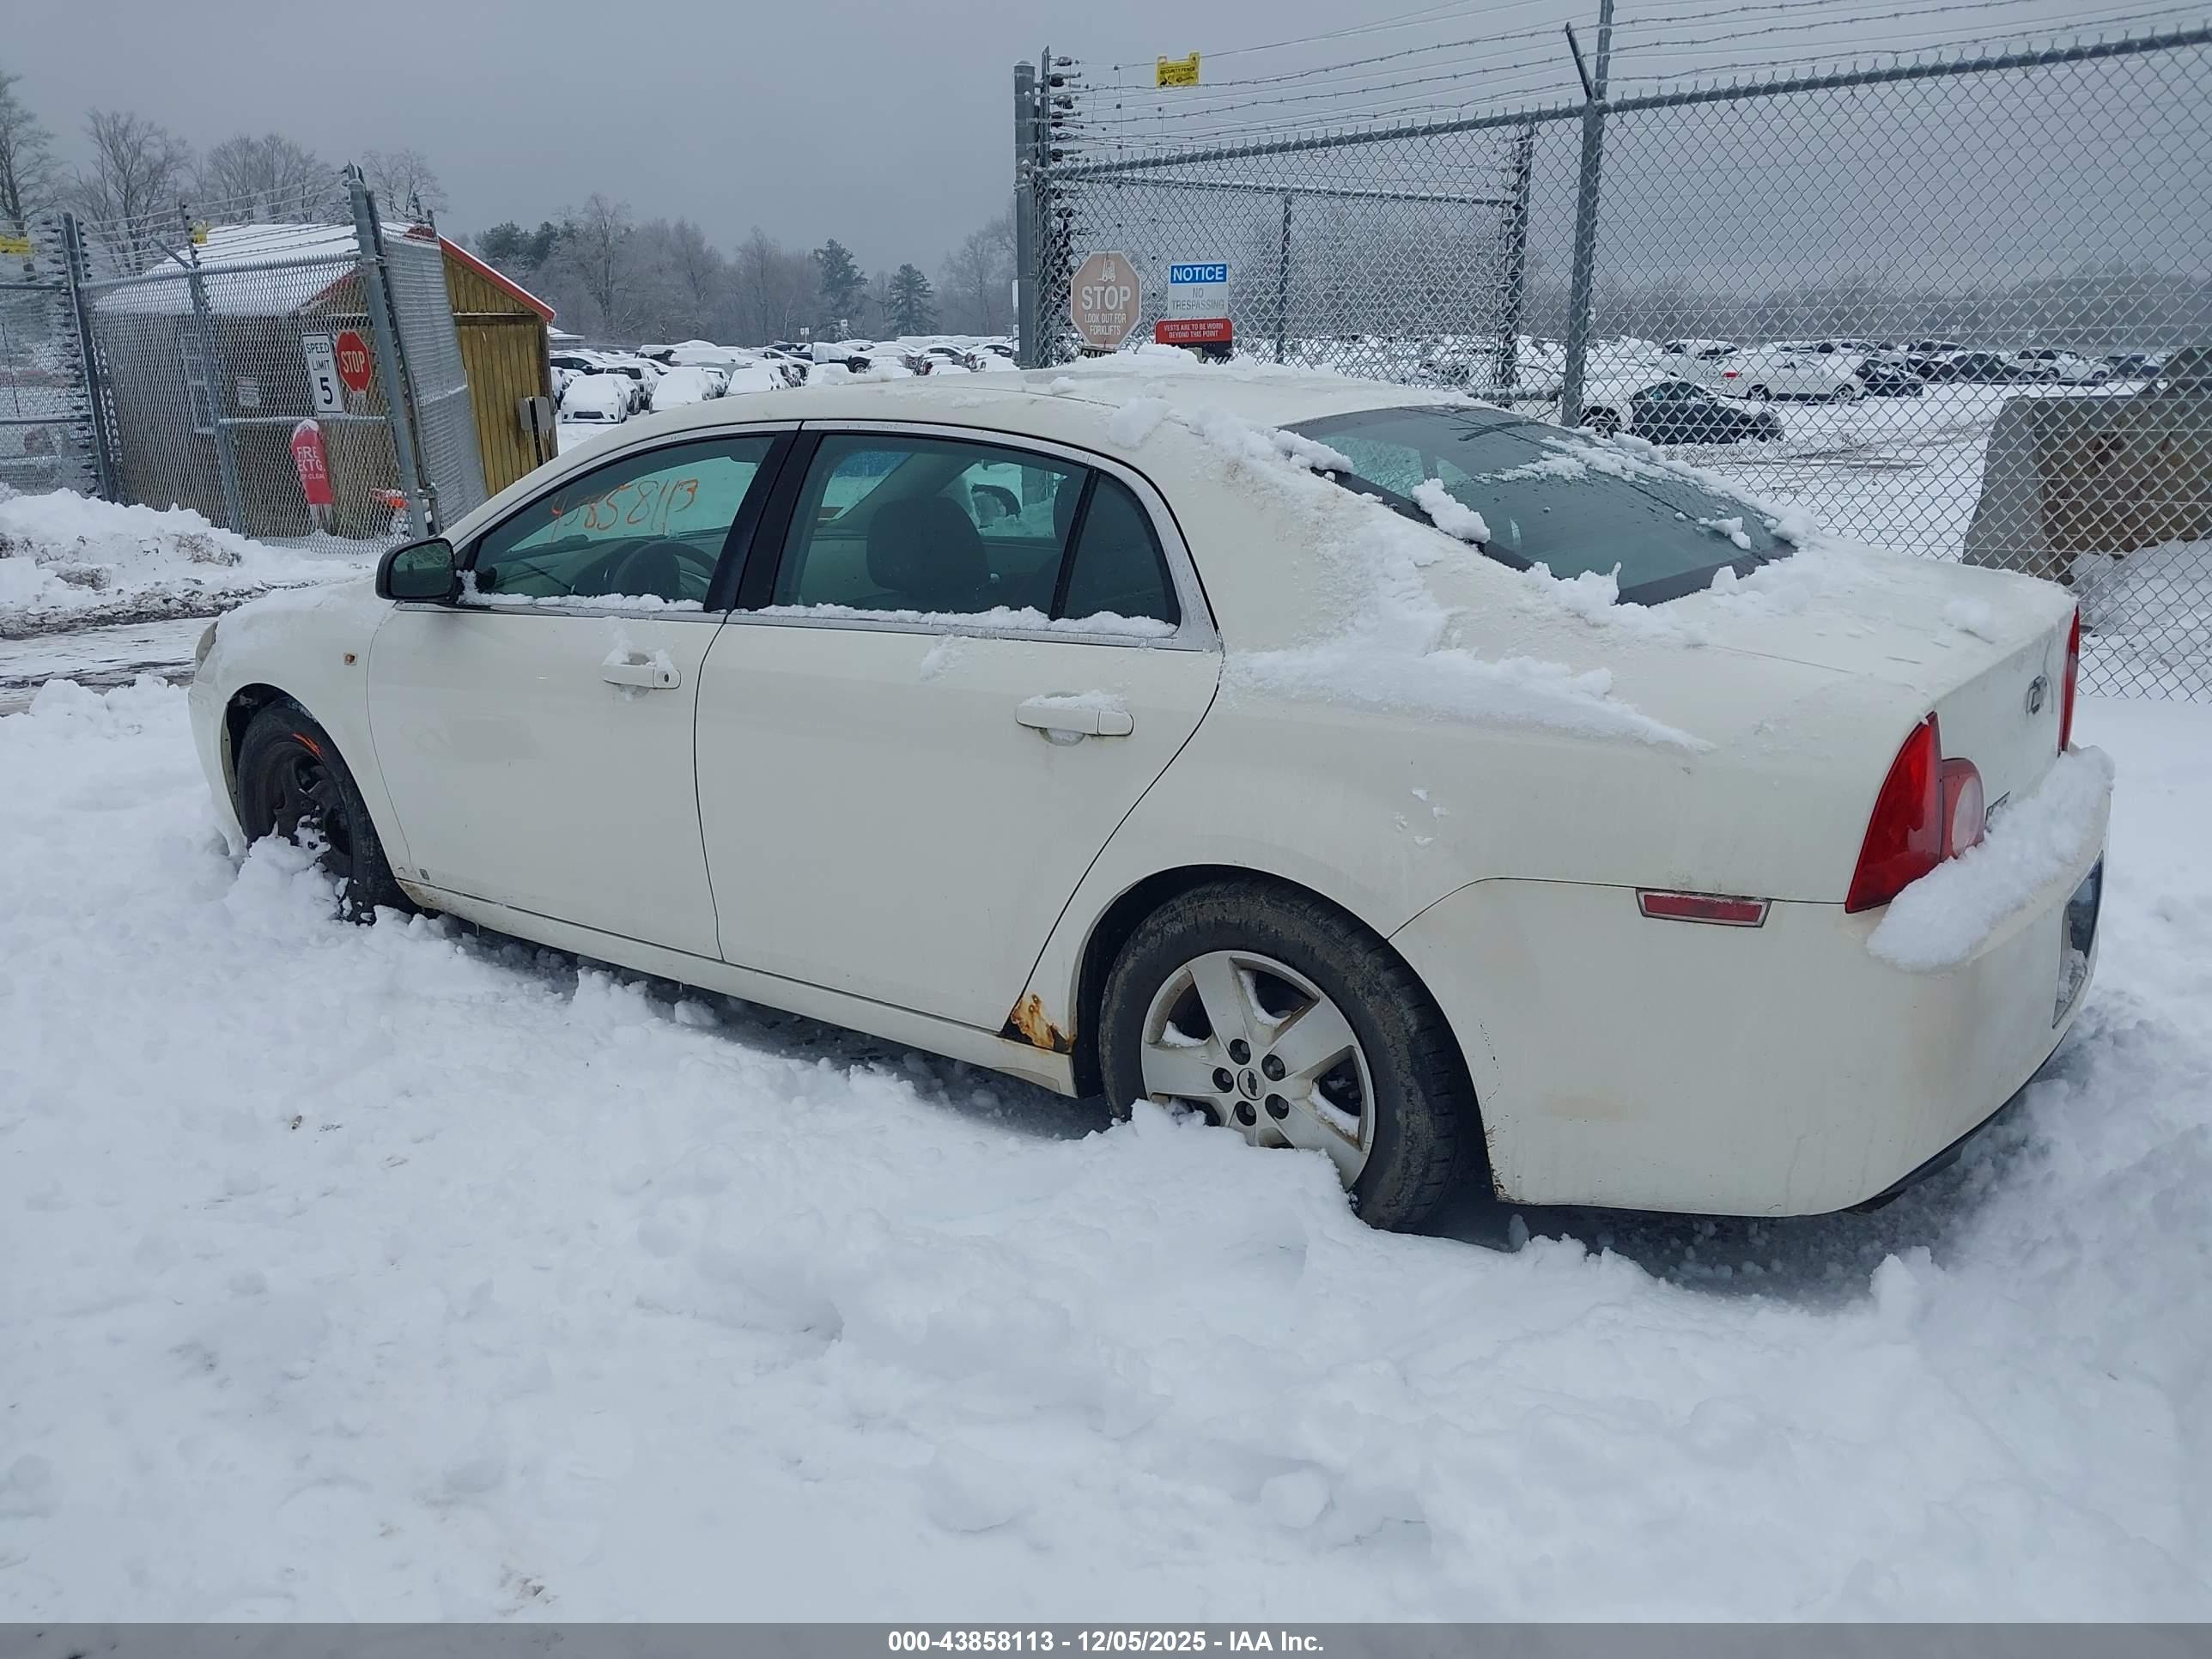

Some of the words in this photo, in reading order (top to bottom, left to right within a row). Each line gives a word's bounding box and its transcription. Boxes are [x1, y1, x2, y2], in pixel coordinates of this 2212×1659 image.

[1173, 266, 1224, 281] NOTICE
[1081, 286, 1131, 310] STOP
[1192, 288, 1204, 298] NO
[1171, 299, 1224, 310] TRESPASSING
[1085, 313, 1100, 324] LOOK
[1101, 313, 1113, 323] OUT
[1114, 313, 1127, 324] FOR
[1090, 325, 1121, 335] FORKLIFTS
[306, 342, 330, 354] SPEED
[312, 359, 330, 371] LIMIT
[341, 350, 365, 374] STOP
[319, 377, 333, 404] 5
